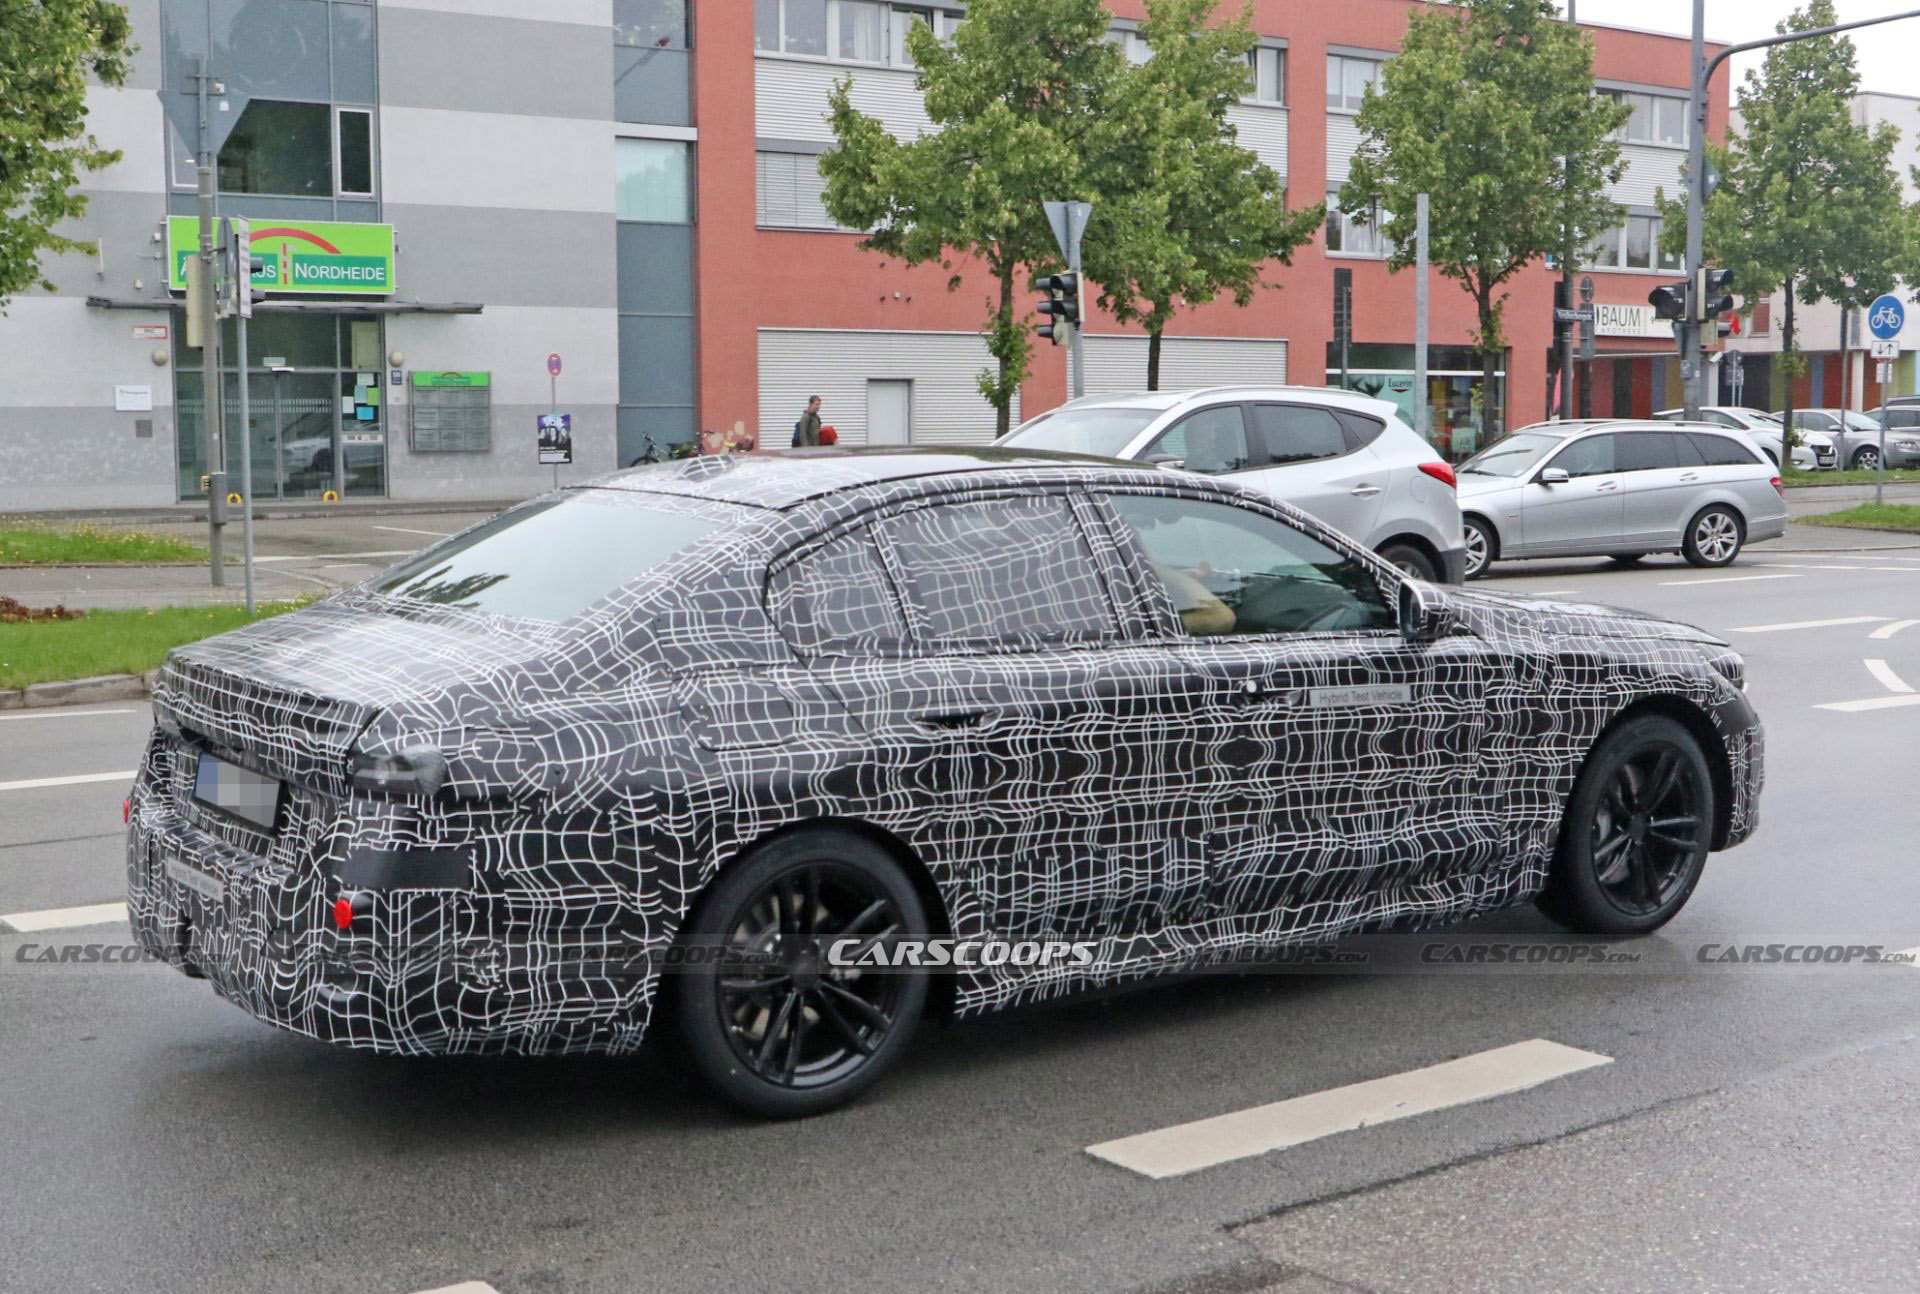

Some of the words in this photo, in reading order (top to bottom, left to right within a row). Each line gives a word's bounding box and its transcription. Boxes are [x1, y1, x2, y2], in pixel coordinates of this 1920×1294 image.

[294, 262, 385, 281] NORDHEIDE
[1601, 306, 1641, 327] BAUM
[1388, 378, 1413, 388] Eucerin
[1319, 692, 1349, 705] Hybrid
[1351, 690, 1370, 702] Test
[1371, 688, 1403, 701] Vehicle
